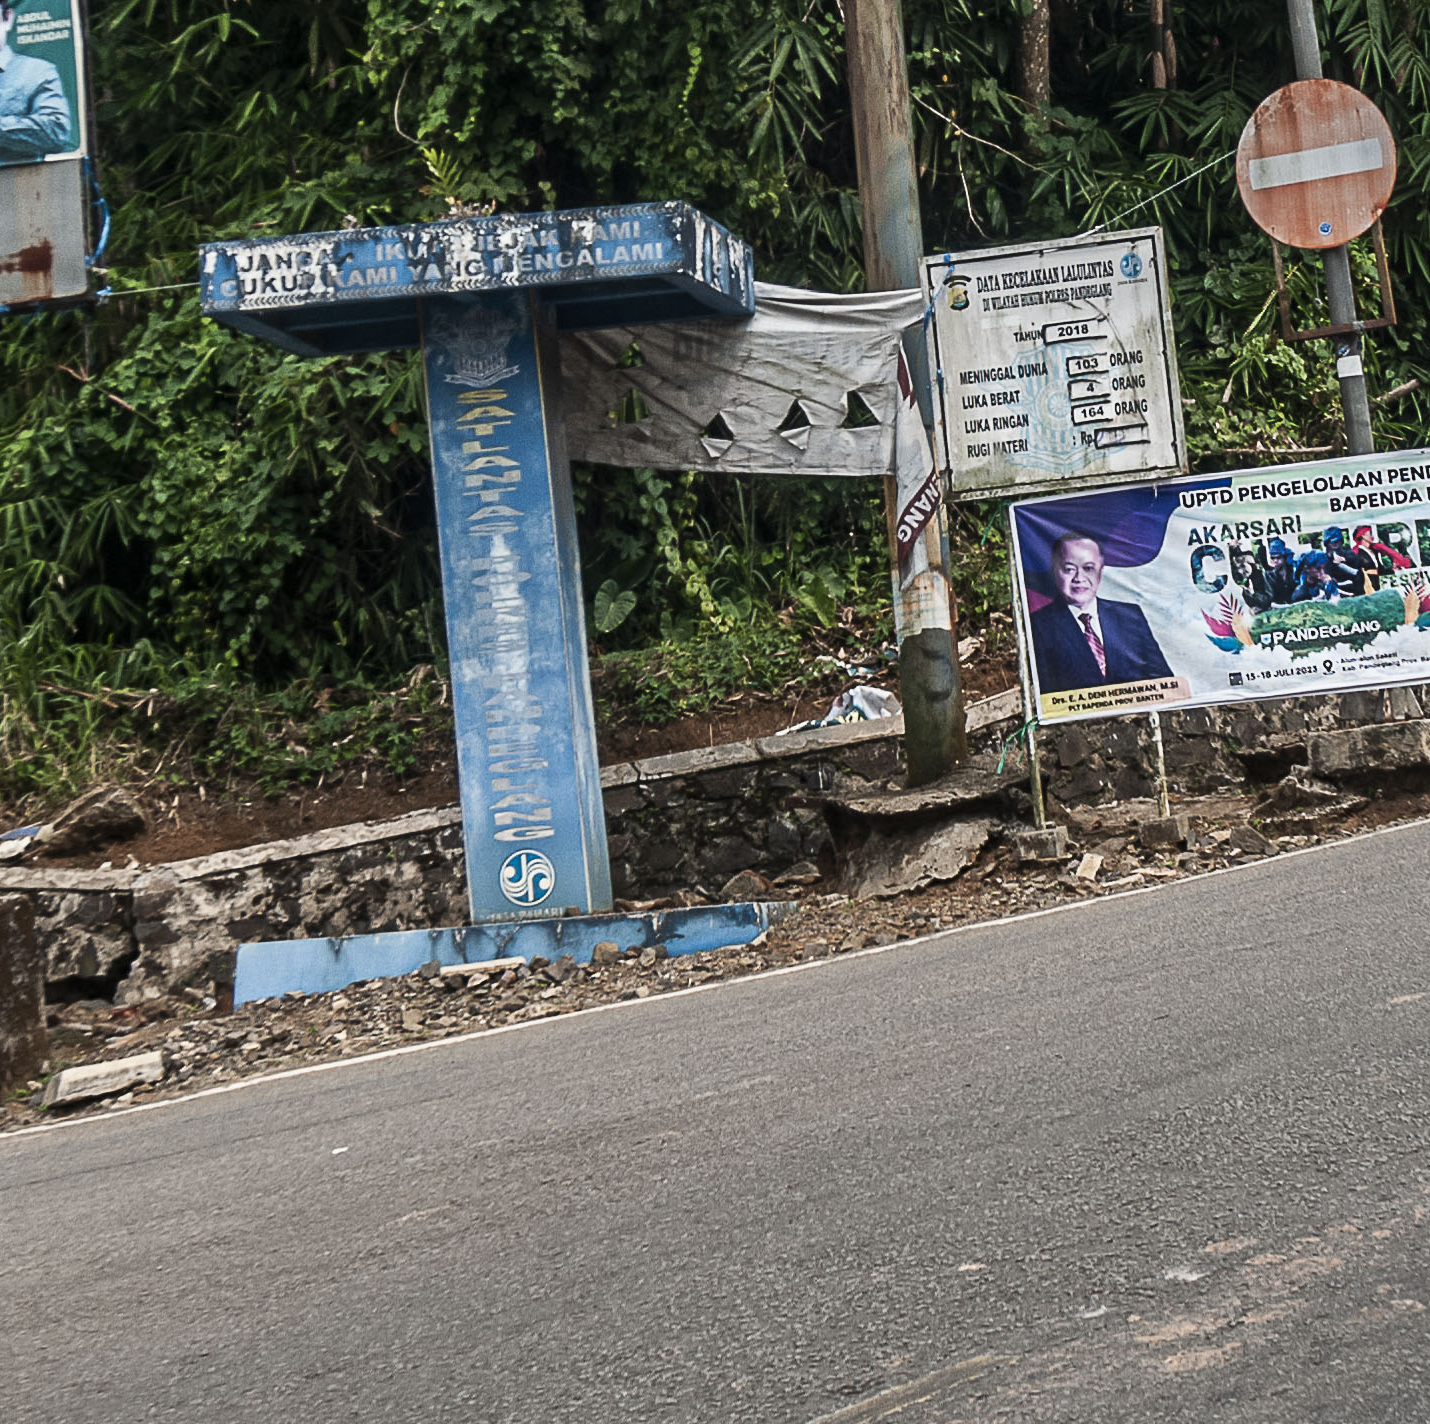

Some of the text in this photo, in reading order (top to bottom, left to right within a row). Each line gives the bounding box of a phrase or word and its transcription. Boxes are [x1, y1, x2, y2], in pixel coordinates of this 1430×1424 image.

[976, 260, 1114, 294] DATA KECELAKAAN LALULINTAS
[982, 299, 991, 312] DI
[1014, 324, 1089, 343] TAHUN 2018
[959, 350, 1144, 386] MENINGGAL DUNIA 103 ORANG
[962, 374, 1146, 410] LUKA BERAT 4 ORANG
[964, 398, 1148, 434] LUKA RINGAN 164 ORANG
[967, 442, 991, 458] RUGI
[1179, 485, 1233, 509] UPTD
[1238, 472, 1384, 503] PENGELOLAAN
[1330, 489, 1423, 514] BAPENDA
[1187, 515, 1303, 546] AKARSARI
[1272, 620, 1382, 645] PANDEGLANG
[1274, 665, 1318, 678] JULI 2023
[1136, 693, 1164, 703] BANTEN
